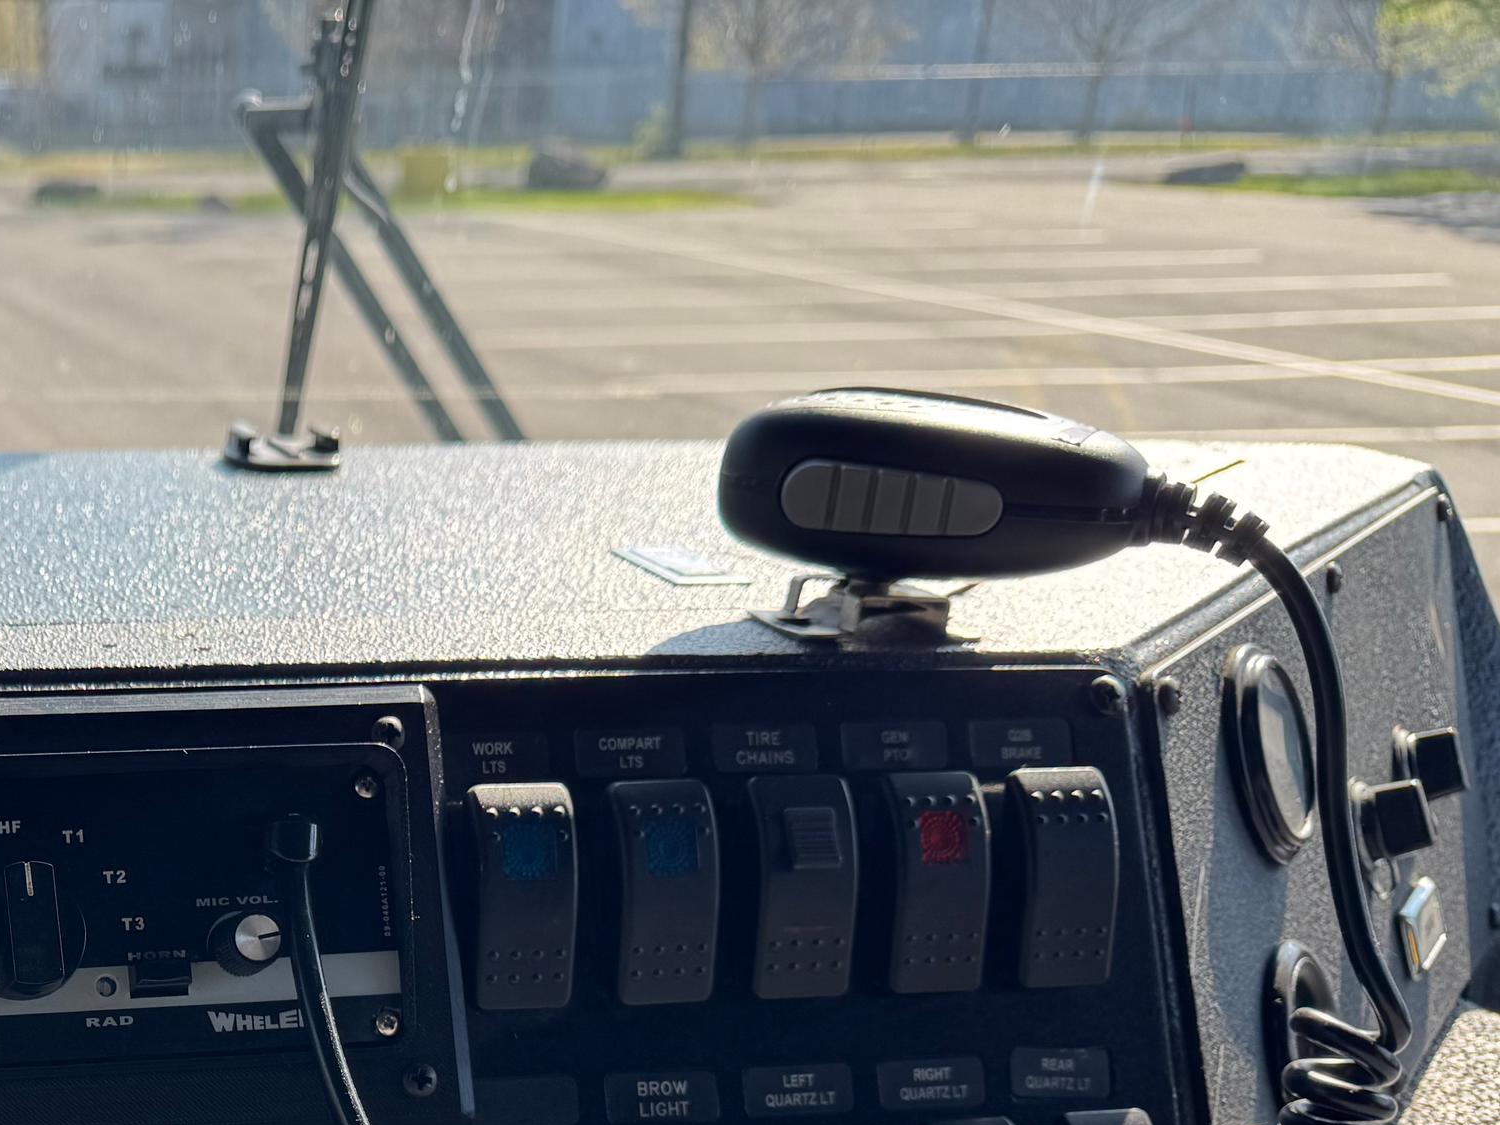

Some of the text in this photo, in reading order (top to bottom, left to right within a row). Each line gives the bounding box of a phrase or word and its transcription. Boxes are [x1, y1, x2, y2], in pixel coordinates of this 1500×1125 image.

[599, 736, 660, 750] COMPART
[746, 731, 780, 745] TIRE
[882, 731, 909, 743] GEN
[472, 742, 512, 755] WORK
[884, 747, 910, 762] PTO
[1001, 746, 1042, 761] BRAKE
[620, 755, 643, 768] LTS
[736, 750, 794, 764] CHAINS
[483, 760, 506, 774] LTS
[0, 821, 20, 834] HF
[63, 829, 83, 843] T1
[103, 871, 126, 883] T2
[196, 896, 278, 906] MIC VOL.
[122, 917, 144, 930] T3
[127, 950, 185, 960] HORN
[86, 1016, 133, 1027] RAD
[207, 1009, 304, 1032] WHELE
[1042, 1058, 1074, 1070] REAR
[783, 1074, 814, 1087] LEFT
[914, 1067, 951, 1080] RIGHT
[637, 1081, 688, 1098] BROW
[1025, 1076, 1092, 1090] QUARTZ LT
[766, 1090, 836, 1107] QUARTZ LT
[900, 1084, 968, 1100] QUARTZ LT
[640, 1101, 689, 1117] LIGHT
